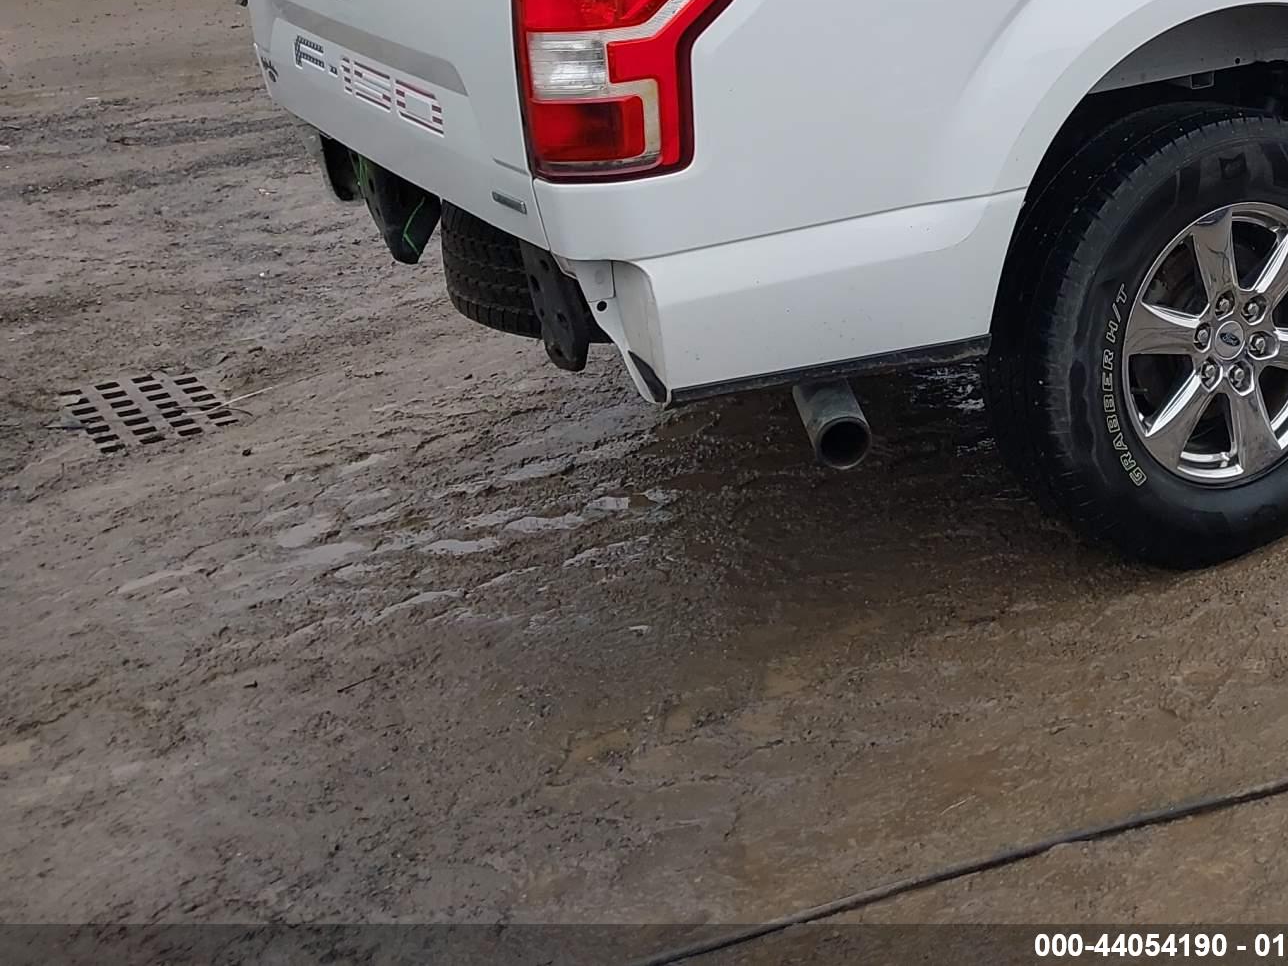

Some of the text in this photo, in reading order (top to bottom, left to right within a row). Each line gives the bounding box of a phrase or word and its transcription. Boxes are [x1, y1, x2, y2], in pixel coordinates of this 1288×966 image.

[292, 34, 445, 138] F-150
[1102, 282, 1147, 487] GRABBER H/T
